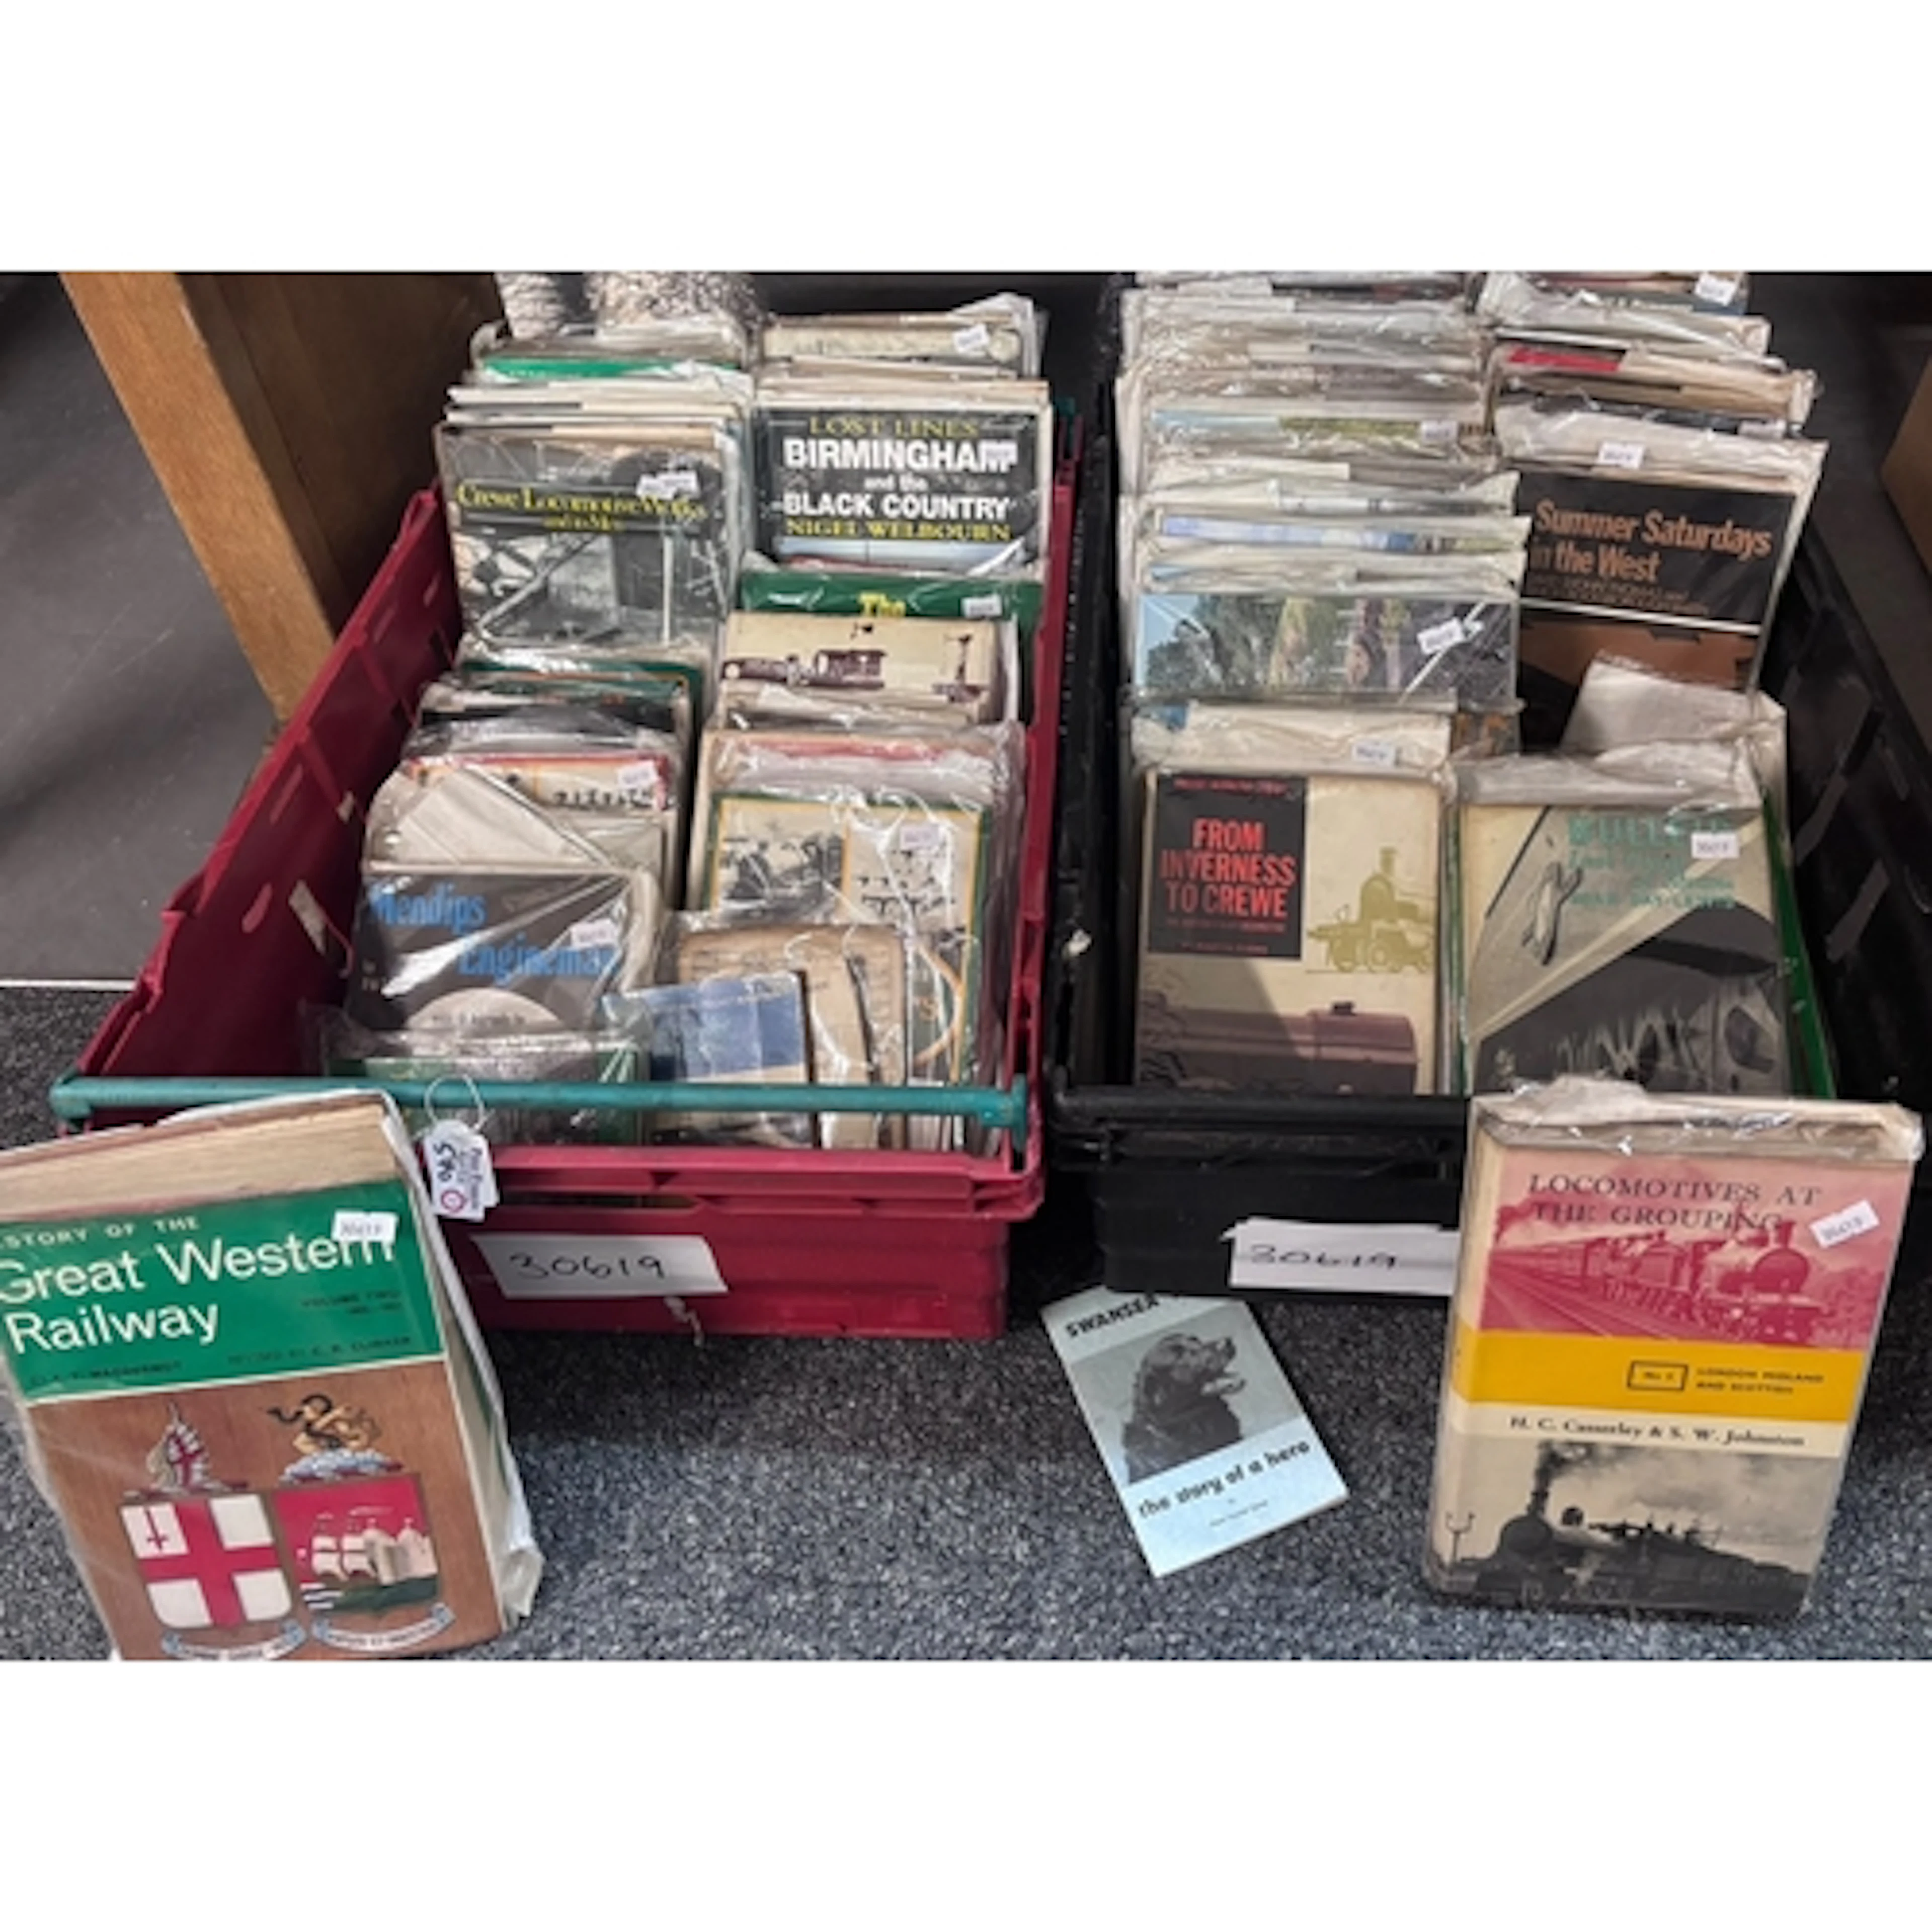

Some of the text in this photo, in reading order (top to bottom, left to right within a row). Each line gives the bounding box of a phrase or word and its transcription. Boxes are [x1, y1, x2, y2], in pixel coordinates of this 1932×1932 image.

[810, 417, 980, 438] LOST LINES
[864, 474, 895, 490] and
[783, 492, 1010, 520] BLACK COUNTRY
[786, 518, 857, 535] NIGEL
[1535, 498, 1773, 562] Summer Saturdays
[1554, 539, 1594, 573] the
[1597, 543, 1661, 582] West
[1191, 817, 1266, 853] FROM
[1161, 848, 1298, 887] INVERNESS
[1165, 881, 1289, 919] TO CREWE
[1527, 1173, 1822, 1206] LOCOMOTIVES AT
[1532, 1201, 1784, 1231] THE GROUPING
[0, 1250, 146, 1304] Great
[508, 1251, 665, 1279] 30619
[5, 1303, 219, 1354] Railway
[1139, 1440, 1311, 1518] the story of a hero
